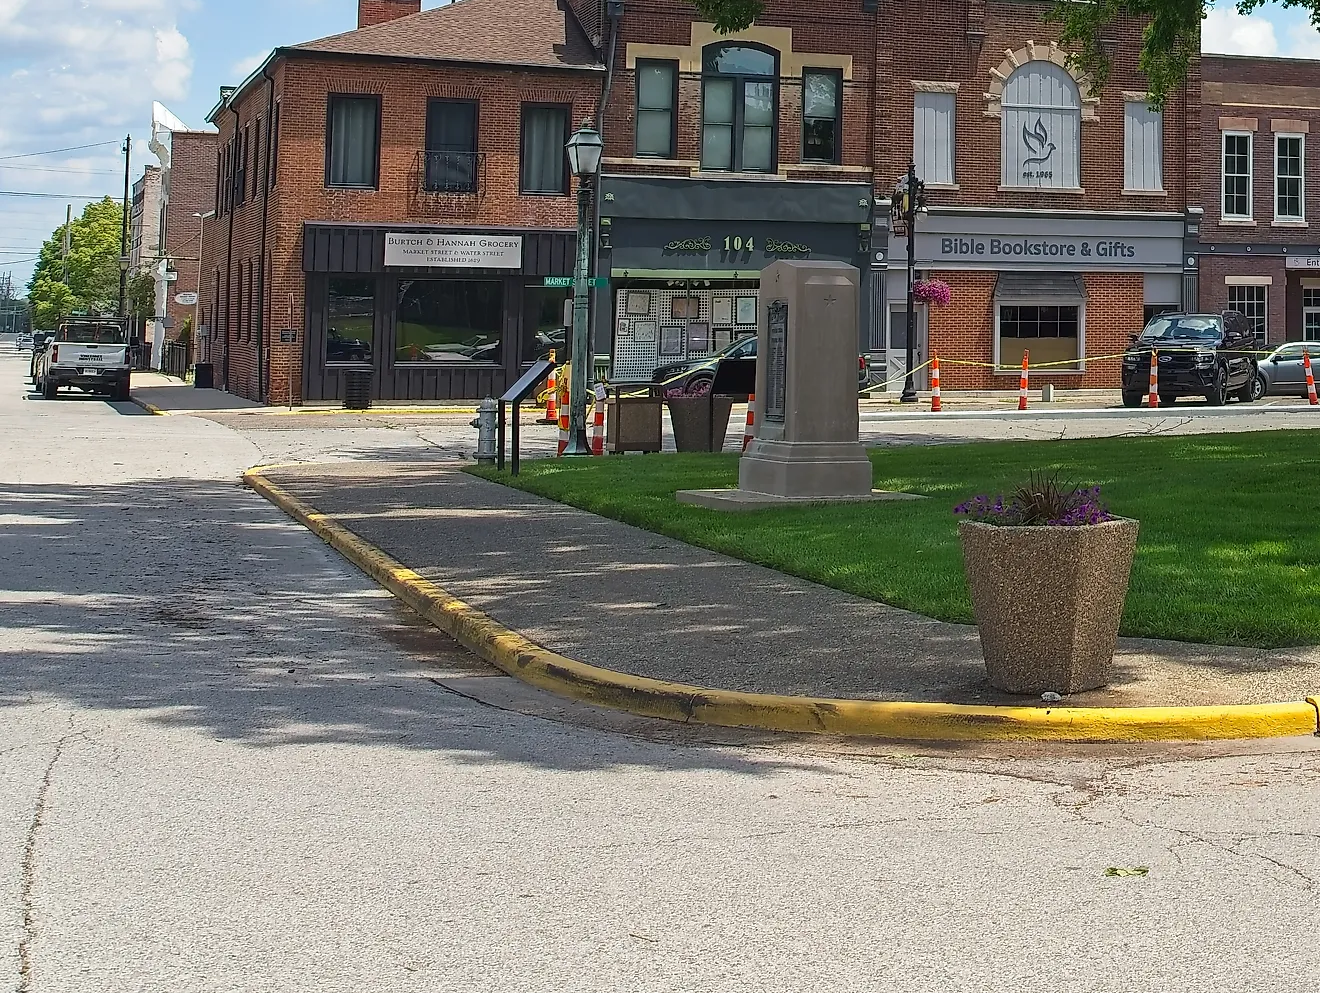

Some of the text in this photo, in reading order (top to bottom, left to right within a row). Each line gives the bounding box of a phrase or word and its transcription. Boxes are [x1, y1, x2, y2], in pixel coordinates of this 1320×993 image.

[388, 237, 519, 248] BURTCH & HANNAH GROCERY
[723, 236, 754, 252] 104
[941, 238, 1135, 258] Bible Bookstore & Gifts
[545, 277, 597, 286] MARKET SET
